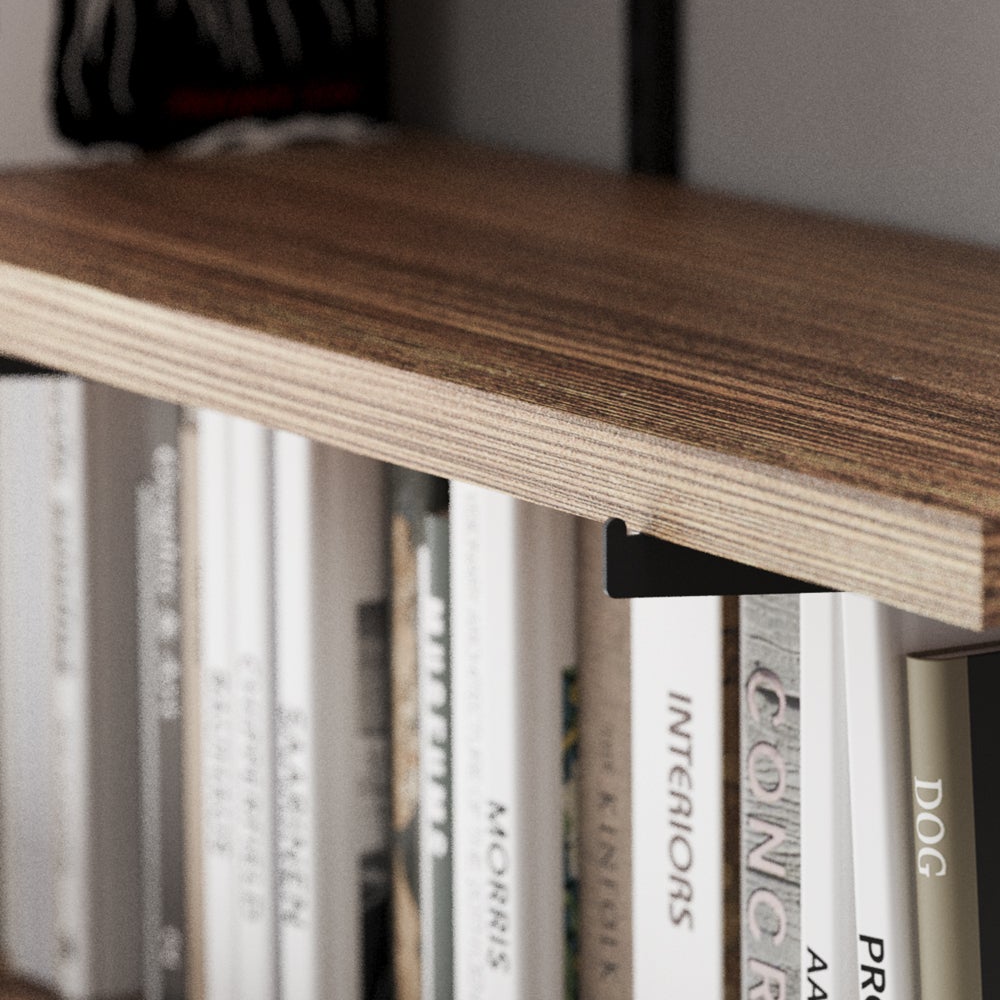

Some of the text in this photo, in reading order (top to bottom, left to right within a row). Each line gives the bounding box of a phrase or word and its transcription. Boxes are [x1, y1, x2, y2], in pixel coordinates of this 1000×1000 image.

[666, 689, 695, 933] INTERIORS
[914, 775, 947, 878] DOG
[486, 800, 511, 974] MORRIS
[858, 933, 886, 1000] PR
